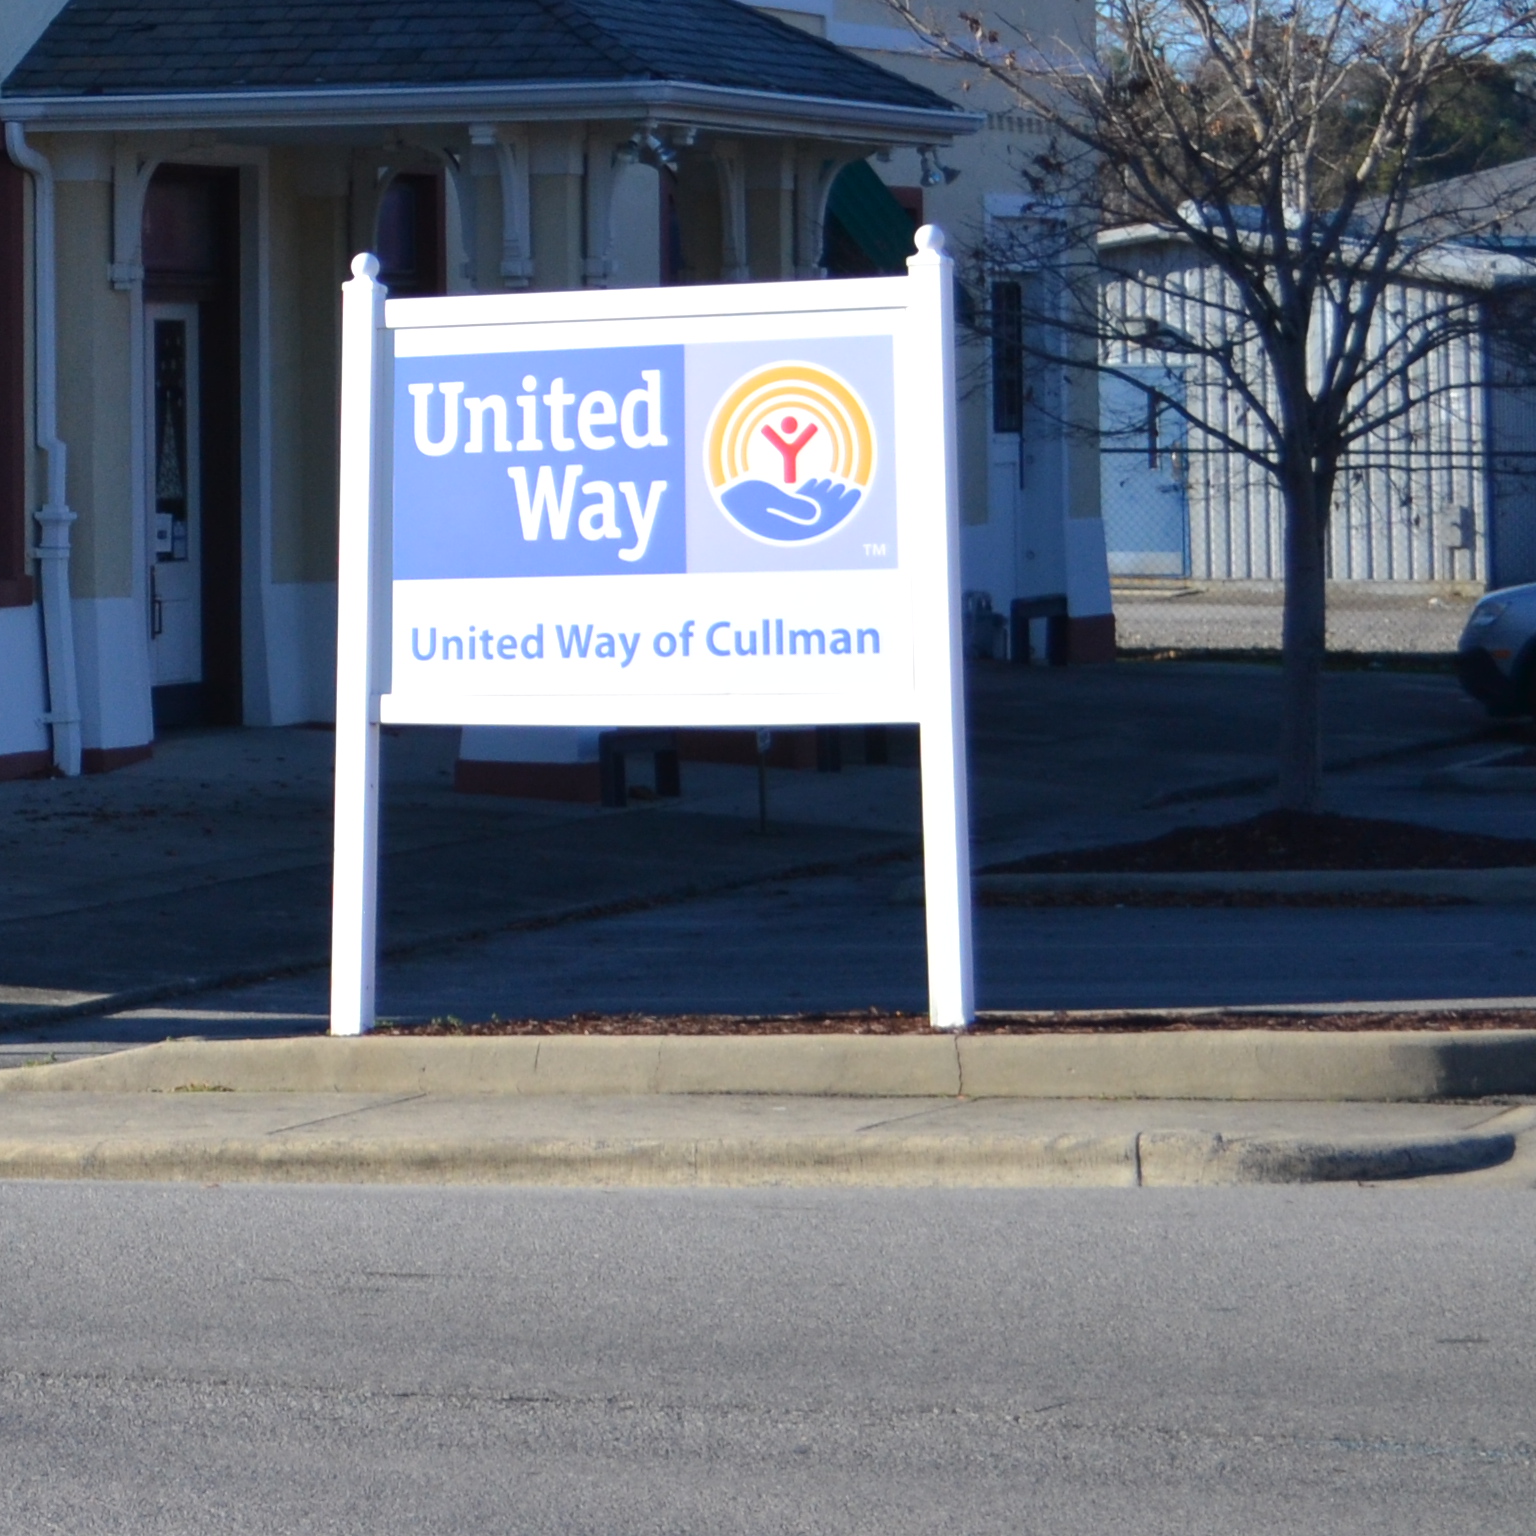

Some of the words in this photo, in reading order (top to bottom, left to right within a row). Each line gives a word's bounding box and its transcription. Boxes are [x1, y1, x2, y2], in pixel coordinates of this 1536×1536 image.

[408, 369, 668, 457] United
[508, 464, 668, 562] Way
[862, 543, 887, 557] TM
[410, 624, 545, 661] United
[555, 624, 641, 668] Way
[652, 620, 695, 658] of
[704, 618, 881, 658] Cullman
